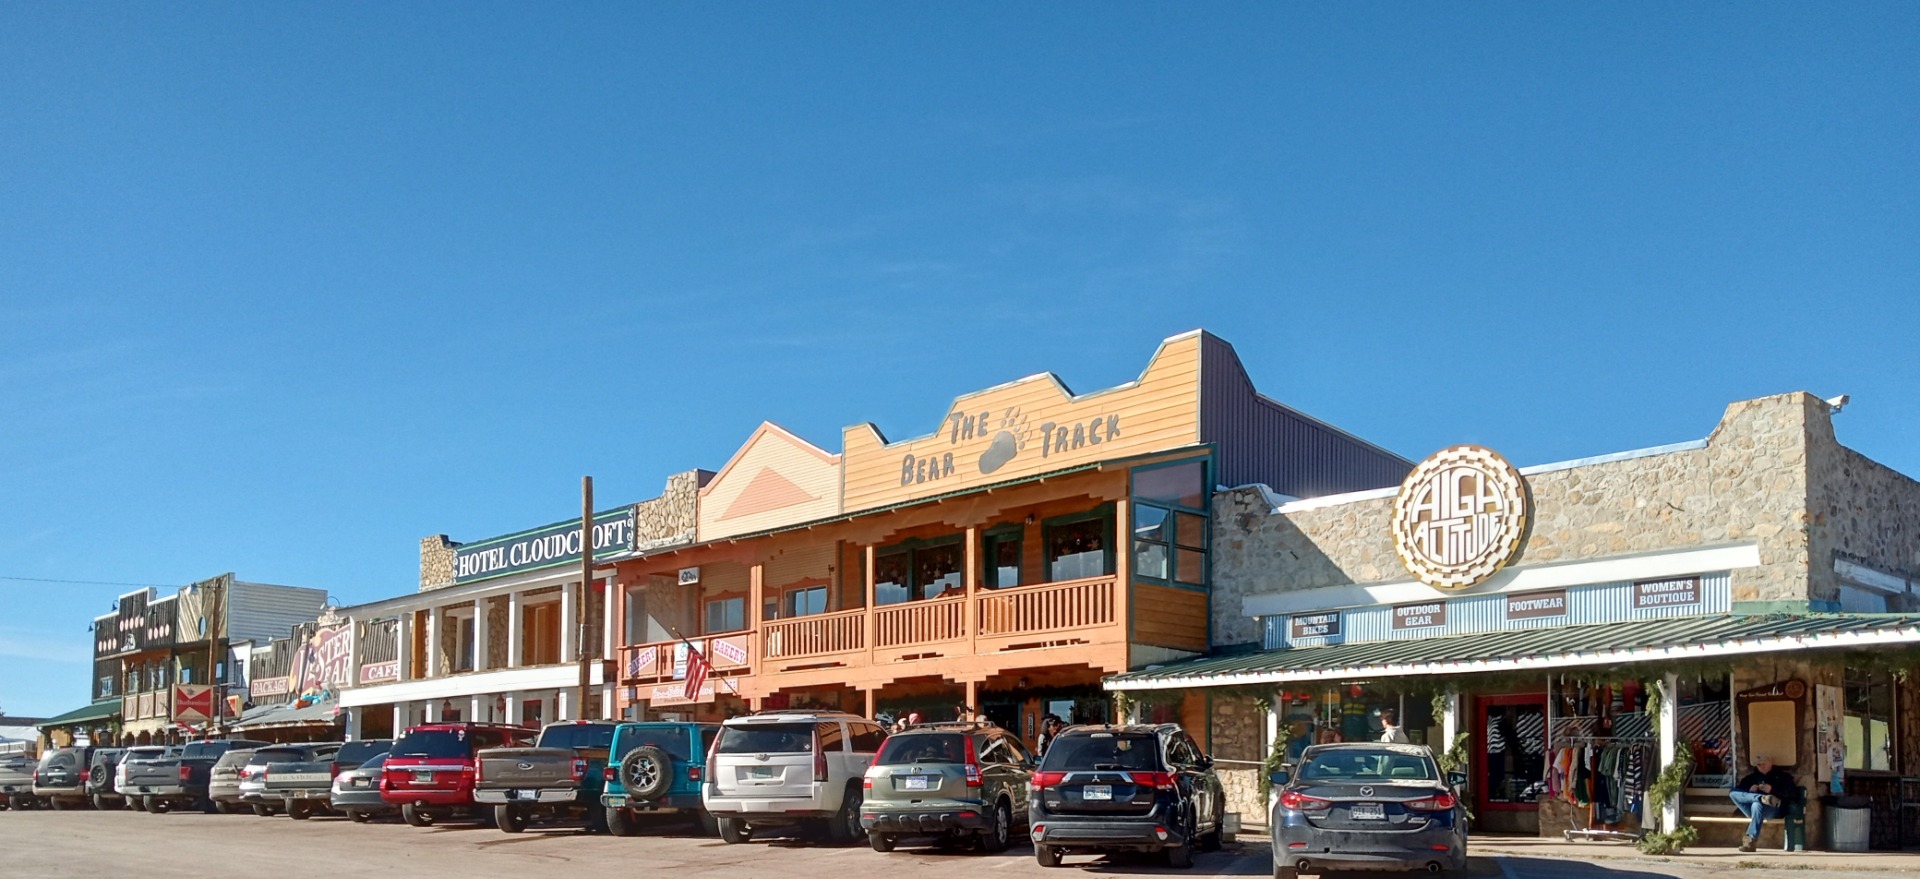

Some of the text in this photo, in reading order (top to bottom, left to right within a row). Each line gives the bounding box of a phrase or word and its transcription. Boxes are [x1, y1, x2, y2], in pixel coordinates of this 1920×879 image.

[950, 410, 990, 444] THE
[901, 413, 1121, 486] BEAR TRACK
[1411, 467, 1504, 523] HIGH
[1413, 511, 1502, 565] ALTITUDE
[458, 547, 508, 578] HOTEL
[1640, 580, 1693, 593] WOMEN'S
[1509, 597, 1563, 612] FOOTWEAR
[1639, 592, 1695, 605] BOUTIQUE
[1397, 604, 1441, 617] OUTDOOR
[1295, 614, 1337, 626] MOUNTAIN
[1405, 616, 1433, 626] GEAR
[1302, 624, 1329, 635] BIKES
[714, 640, 745, 663] BAKERY
[628, 648, 655, 674] BAKERY
[253, 681, 287, 694] PACKAGE
